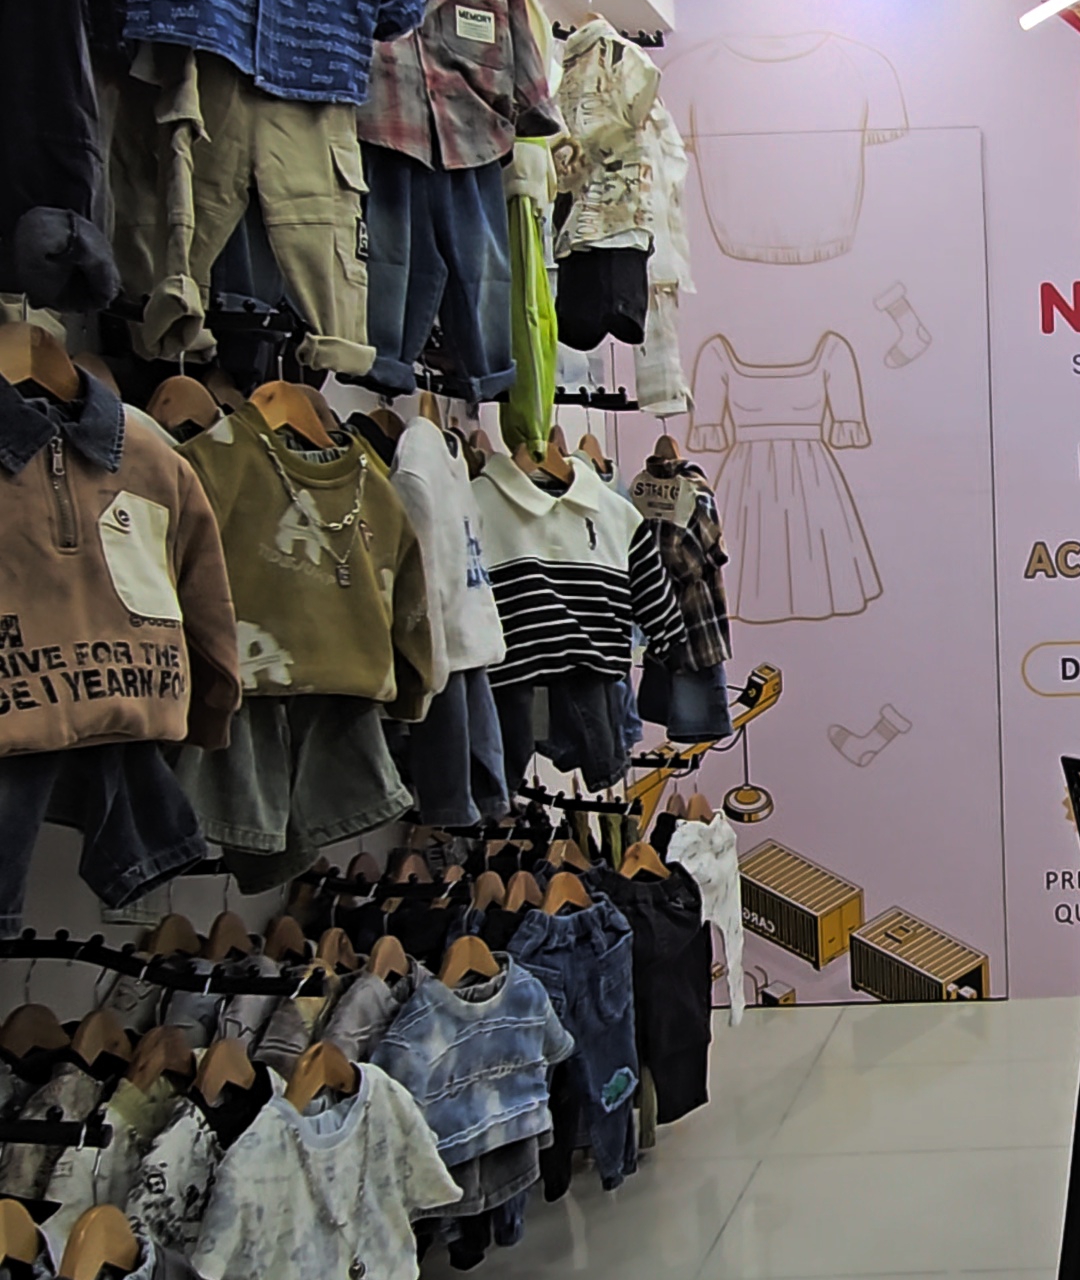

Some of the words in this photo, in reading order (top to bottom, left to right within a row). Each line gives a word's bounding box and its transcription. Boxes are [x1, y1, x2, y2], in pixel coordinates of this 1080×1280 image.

[73, 641, 133, 666] FOR
[139, 641, 181, 668] THE
[40, 675, 59, 704] I
[60, 668, 154, 703] YEARN
